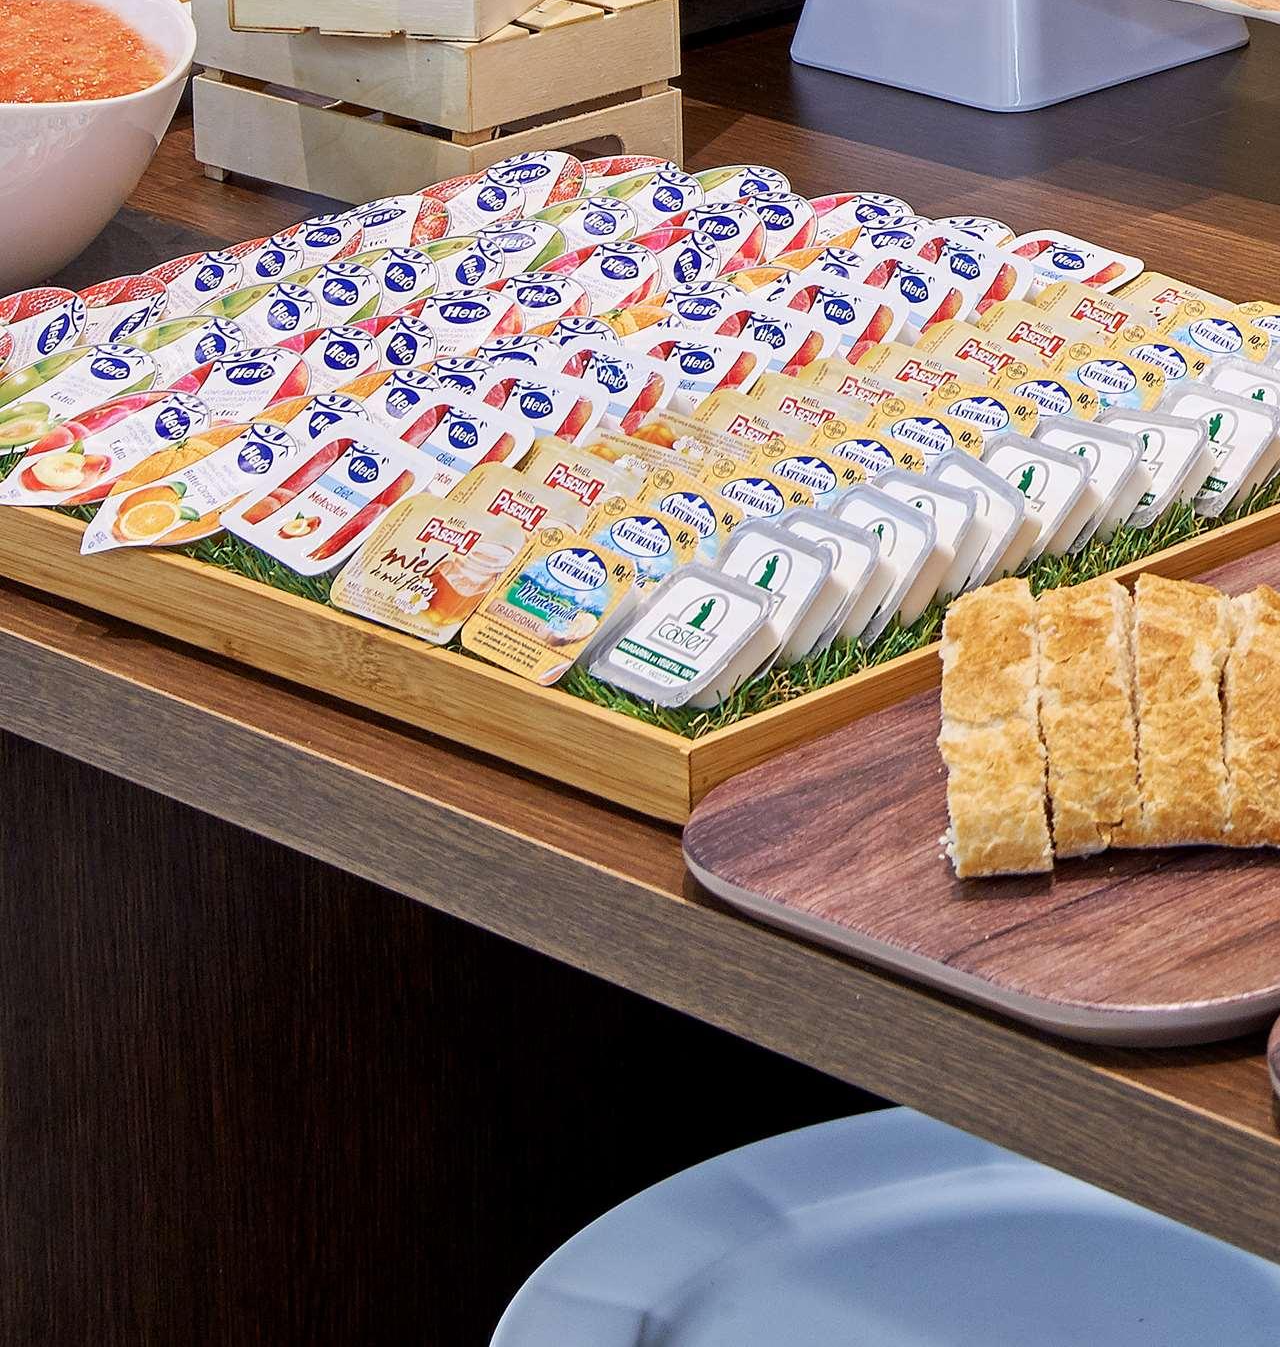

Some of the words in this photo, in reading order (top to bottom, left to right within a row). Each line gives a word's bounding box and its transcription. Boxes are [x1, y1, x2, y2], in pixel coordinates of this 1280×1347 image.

[480, 187, 504, 210] Hero
[654, 189, 681, 211] Hero
[584, 214, 614, 235] Hero
[700, 219, 738, 237] Hero
[759, 208, 792, 229] Hero
[306, 230, 341, 245] Hero
[386, 266, 414, 290] Hero
[323, 282, 358, 305] Hero
[520, 288, 561, 305] Hero
[270, 303, 297, 328] Hero
[442, 306, 489, 320] Hero
[389, 337, 414, 363] Hero
[1009, 323, 1065, 356] PASCUAL
[325, 344, 358, 368] Hero
[682, 355, 714, 371] Hero
[92, 358, 129, 378] Hero
[229, 364, 274, 380] Hero
[862, 376, 882, 390] MIEL
[522, 396, 552, 416] Hero
[801, 395, 821, 409] MIEL
[753, 416, 770, 430] MIEL
[450, 425, 476, 447] Hero
[894, 422, 946, 452] ASTURIANA
[241, 444, 268, 473] Hero
[436, 451, 456, 467] diet
[351, 460, 377, 481] Hero
[774, 463, 829, 491] ASTURIANA
[333, 485, 353, 500] diet
[546, 464, 604, 506] PASCUAL
[1208, 479, 1226, 492] 100%
[516, 490, 535, 503] MIEL
[722, 486, 777, 514] ASTURIANA
[489, 491, 547, 531] PASCUAL
[660, 499, 710, 536] ASTURIANA
[448, 517, 467, 530] MIEL
[419, 519, 479, 554] PASCUAL
[612, 522, 664, 554] ASTURIANA
[549, 554, 599, 588] ASTURIANA
[517, 579, 580, 623] Mantequilla
[494, 603, 541, 633] TRADICIONAL
[658, 622, 709, 651] caster
